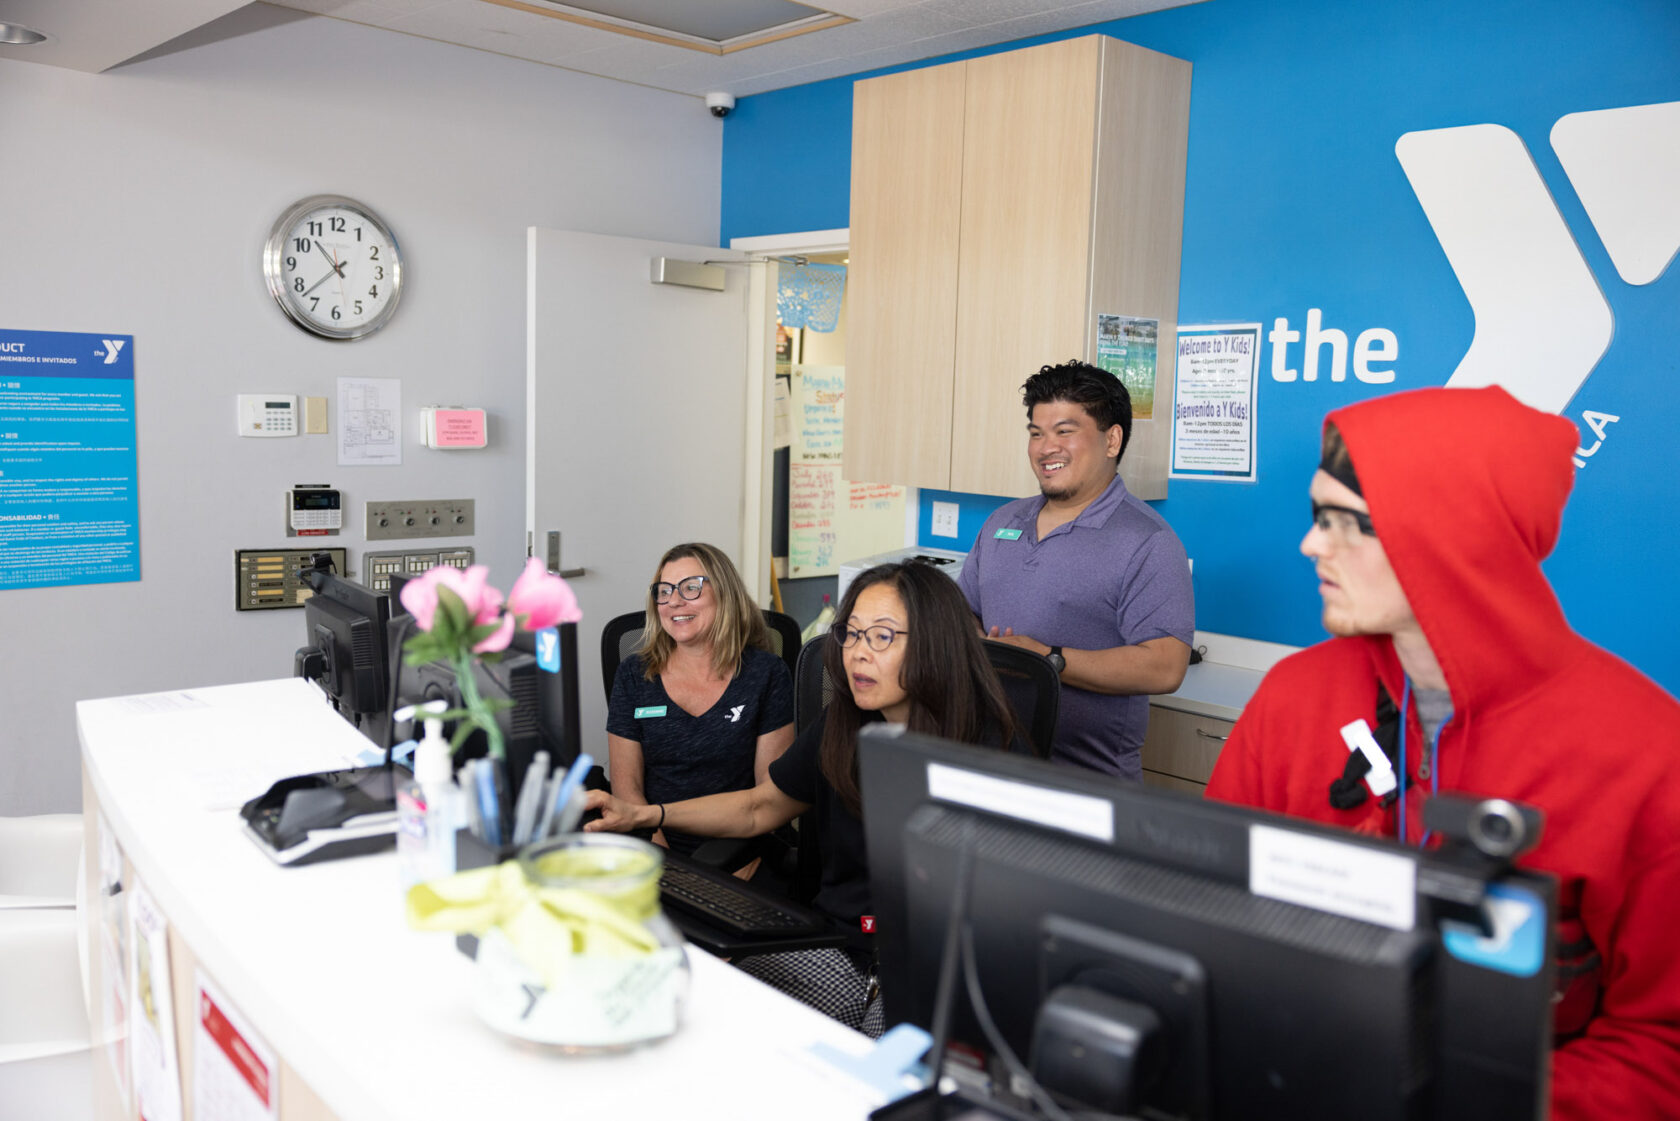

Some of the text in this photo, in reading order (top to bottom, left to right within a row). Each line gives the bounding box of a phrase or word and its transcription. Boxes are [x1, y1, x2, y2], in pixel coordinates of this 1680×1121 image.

[307, 221, 323, 237] 11
[328, 216, 346, 233] 12
[354, 227, 362, 242] 1
[293, 237, 311, 253] 10
[369, 246, 379, 261] 2
[286, 256, 297, 272] 9
[374, 265, 384, 280] 3
[294, 277, 305, 293] 8
[368, 284, 378, 299] 4
[310, 296, 320, 312] 7
[353, 300, 363, 315] 5
[331, 305, 341, 320] 6
[1179, 337, 1251, 357] Welcome to Y Kids!
[1268, 307, 1399, 384] the
[1176, 400, 1248, 420] Bienvenido a Y Kids!
